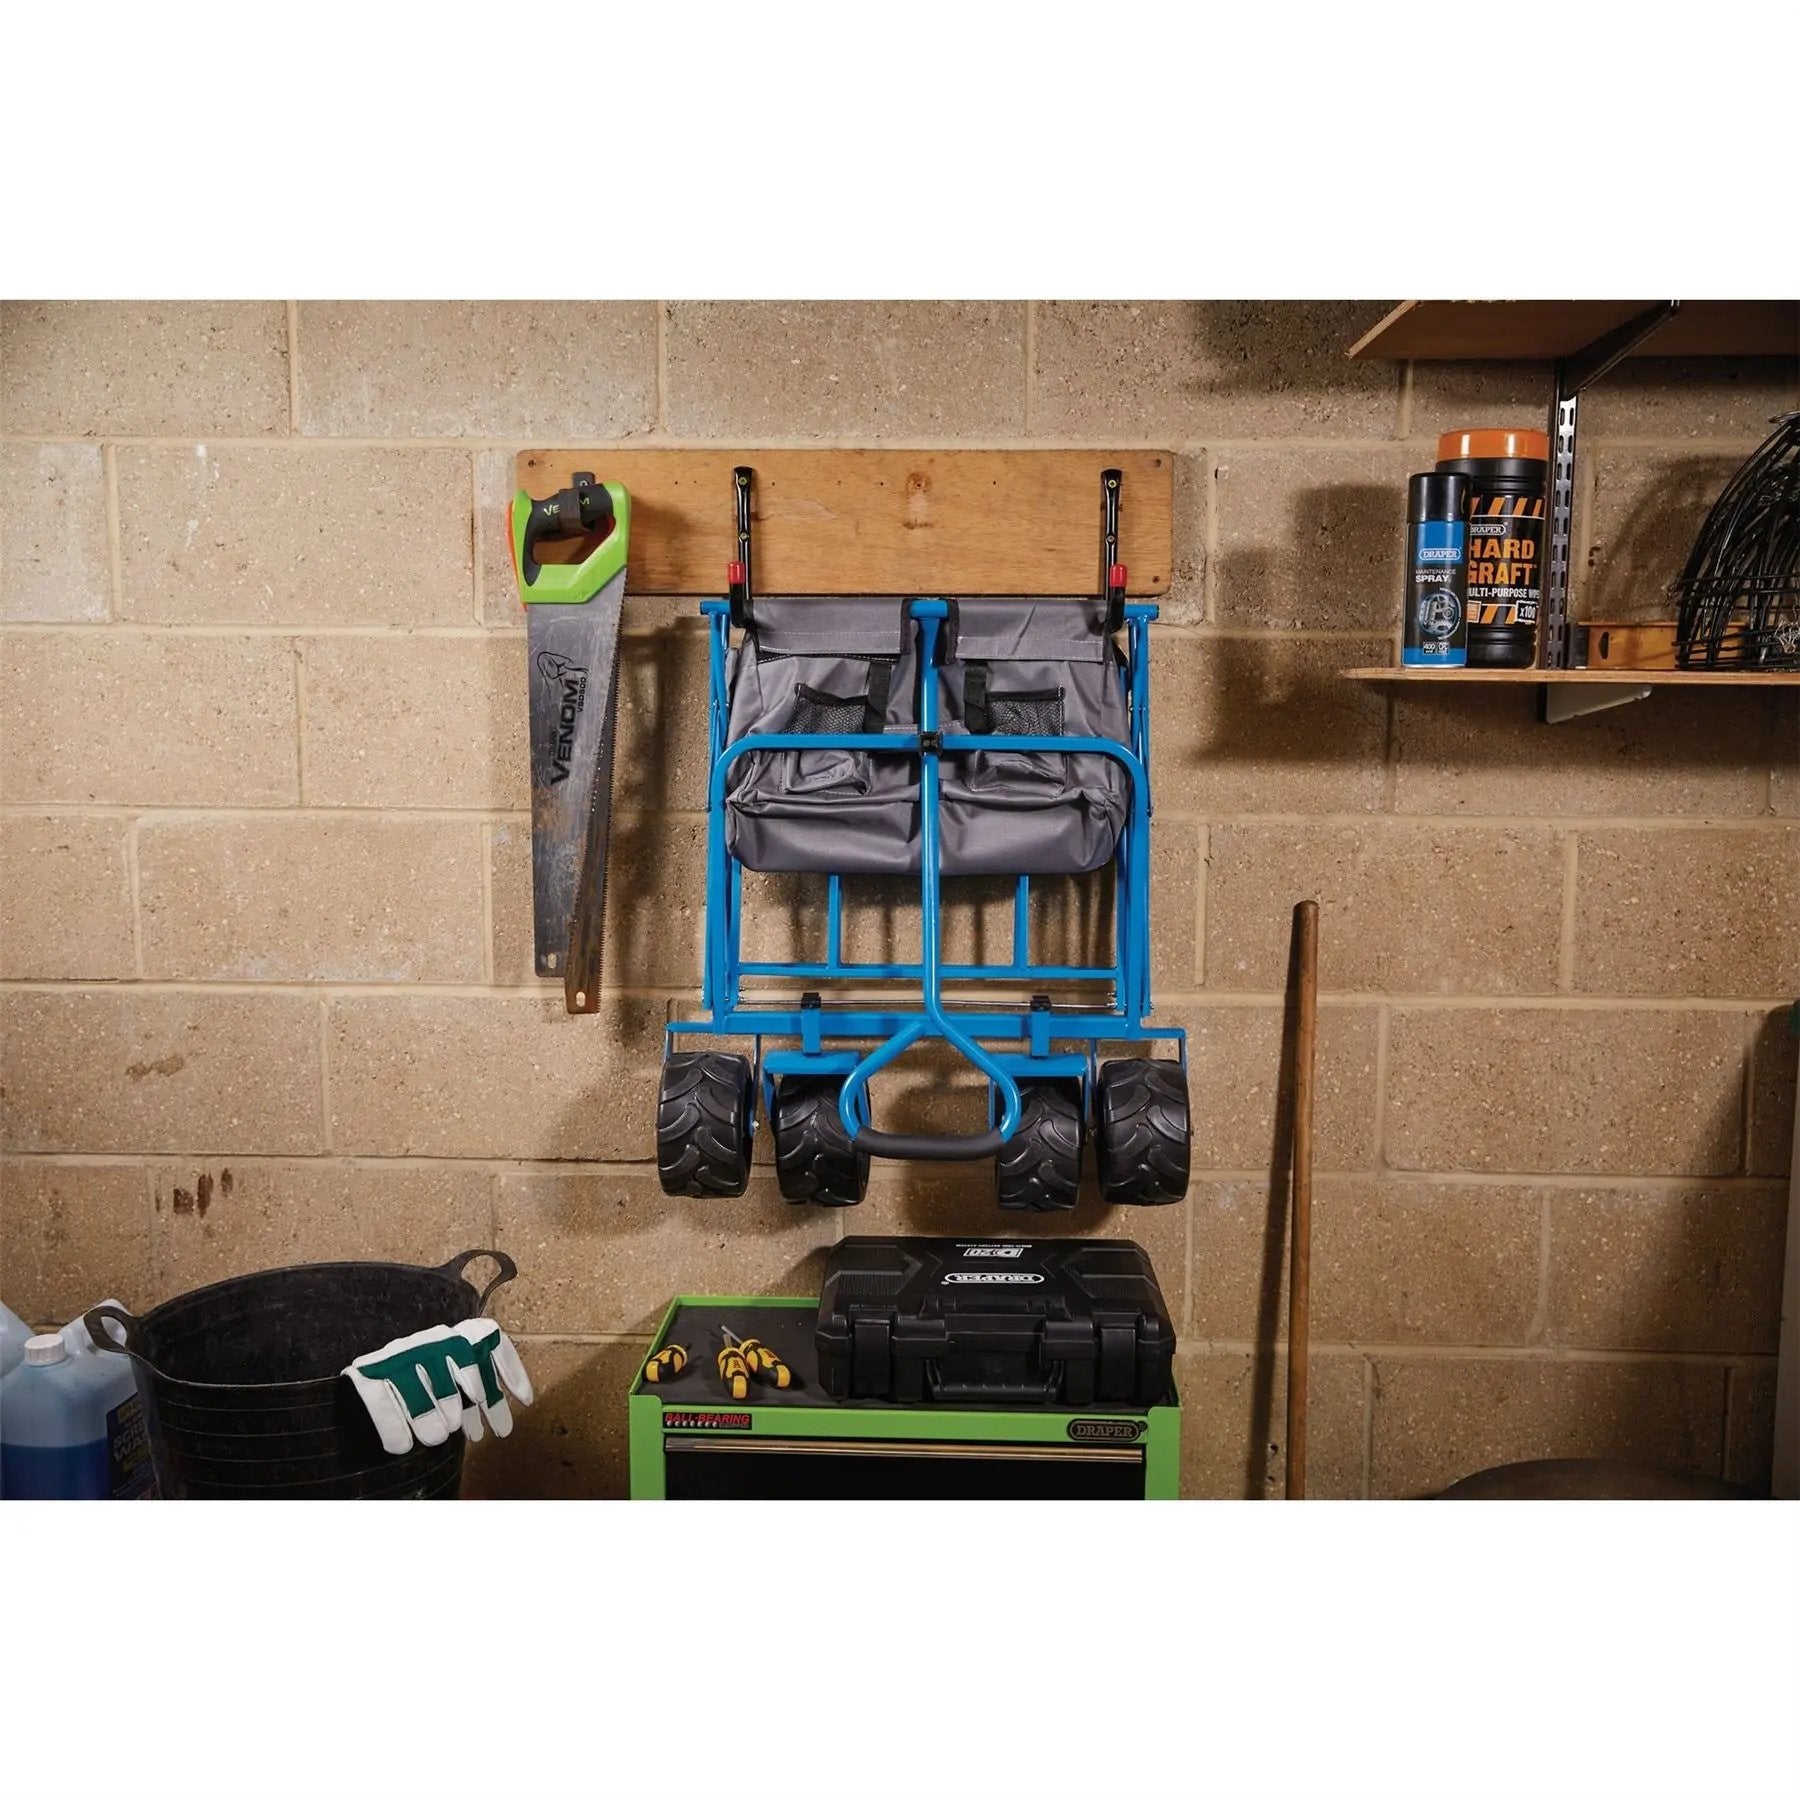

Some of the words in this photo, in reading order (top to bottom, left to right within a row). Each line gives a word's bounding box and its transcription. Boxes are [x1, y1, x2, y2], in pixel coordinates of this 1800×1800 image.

[1469, 538, 1535, 560] HARD
[1415, 575, 1449, 583] SPRAY
[1468, 559, 1533, 586] GRAFT
[1468, 587, 1527, 598] ULTI-PURPOSE
[550, 679, 579, 785] VENOM
[1076, 1424, 1133, 1438] DRAPER
